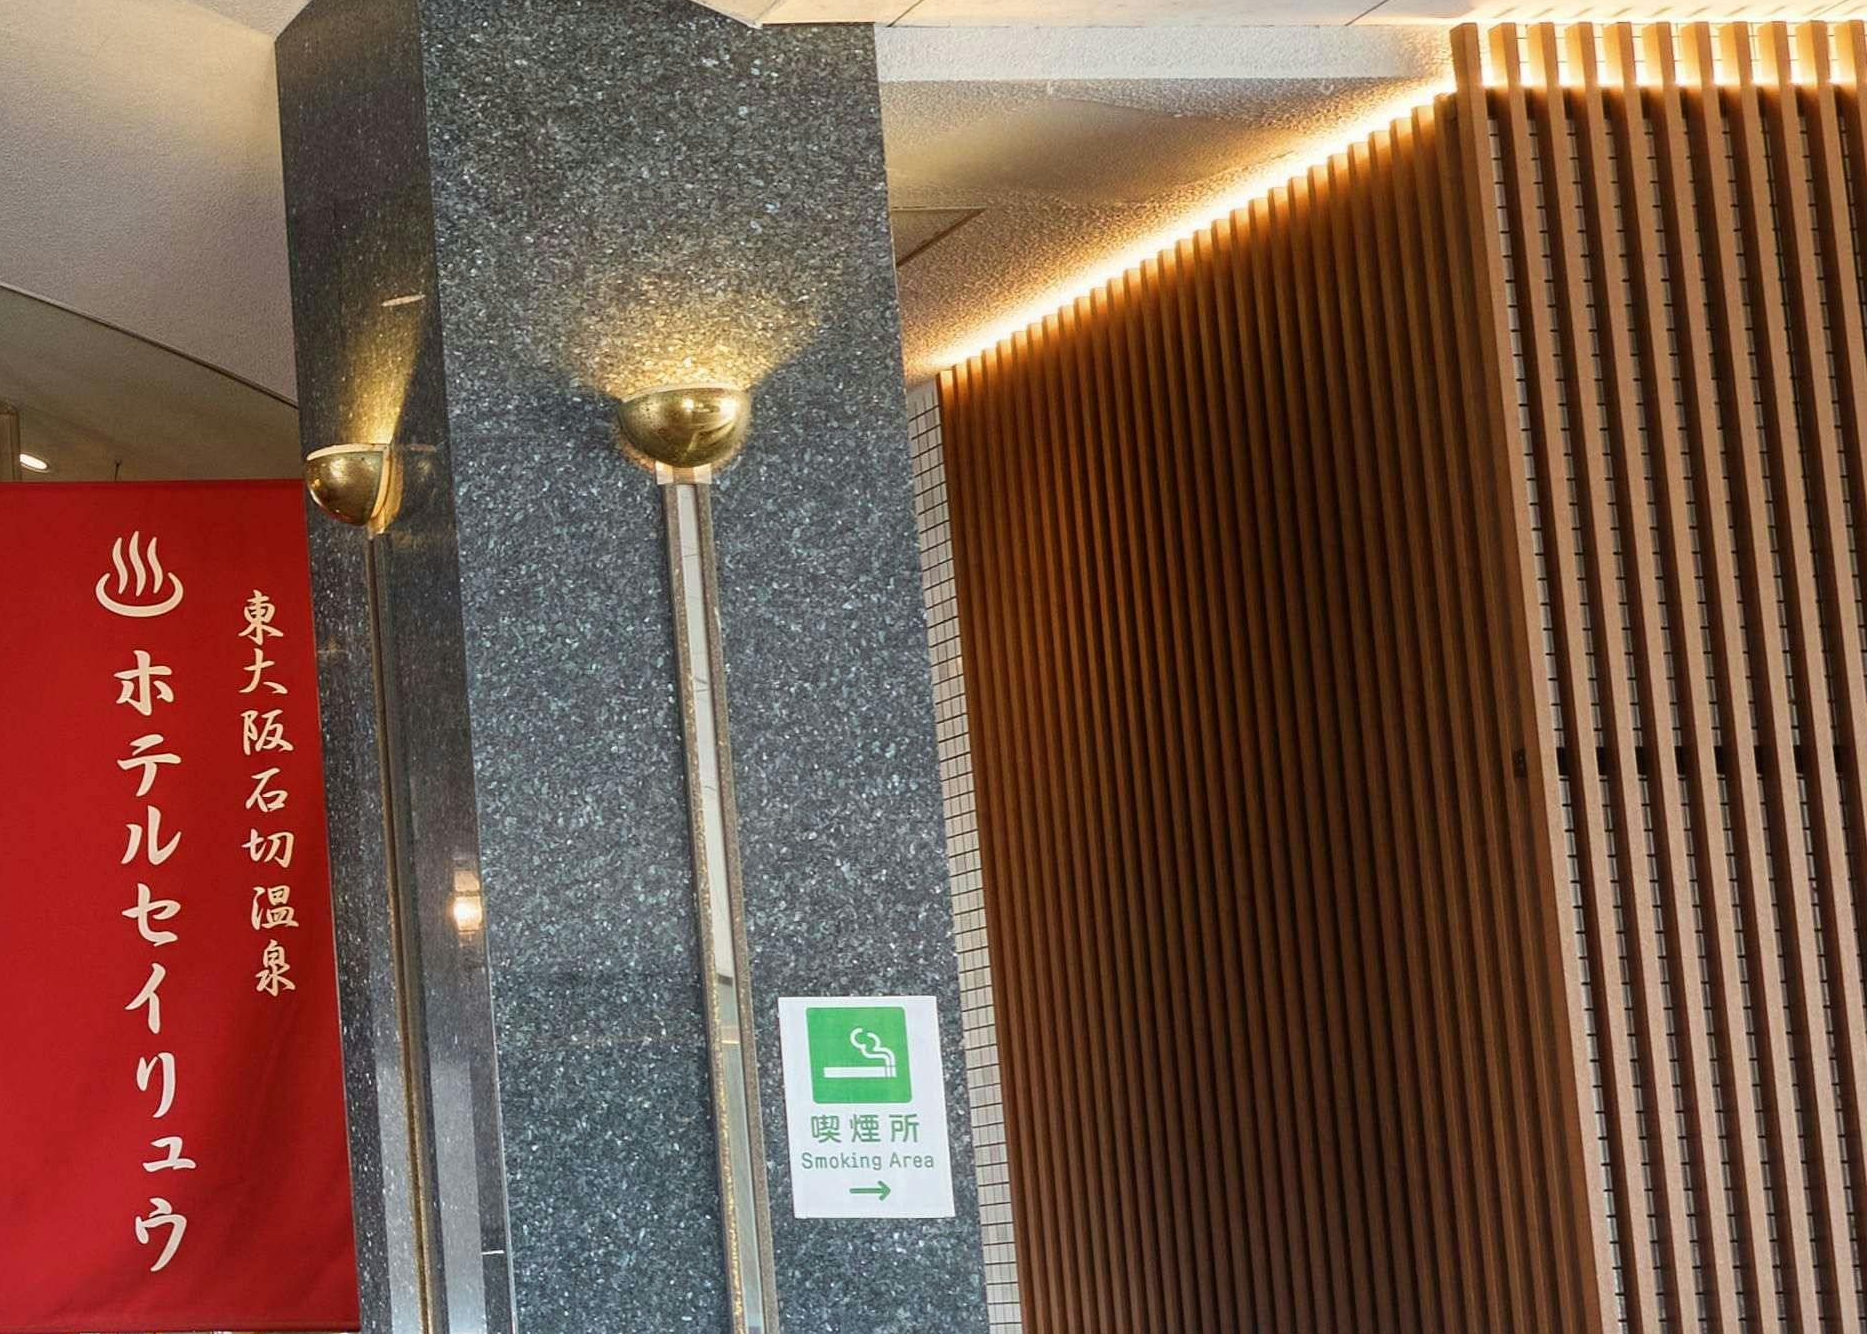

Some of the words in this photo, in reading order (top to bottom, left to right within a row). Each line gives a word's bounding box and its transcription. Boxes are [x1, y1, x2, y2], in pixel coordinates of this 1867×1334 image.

[238, 589, 300, 997] 東大阪石切温泉
[114, 648, 197, 1273] ホテルセイリュウ
[802, 1152, 882, 1170] Smoking
[889, 1152, 934, 1169] Area
[810, 1113, 920, 1144] 喫煙所
